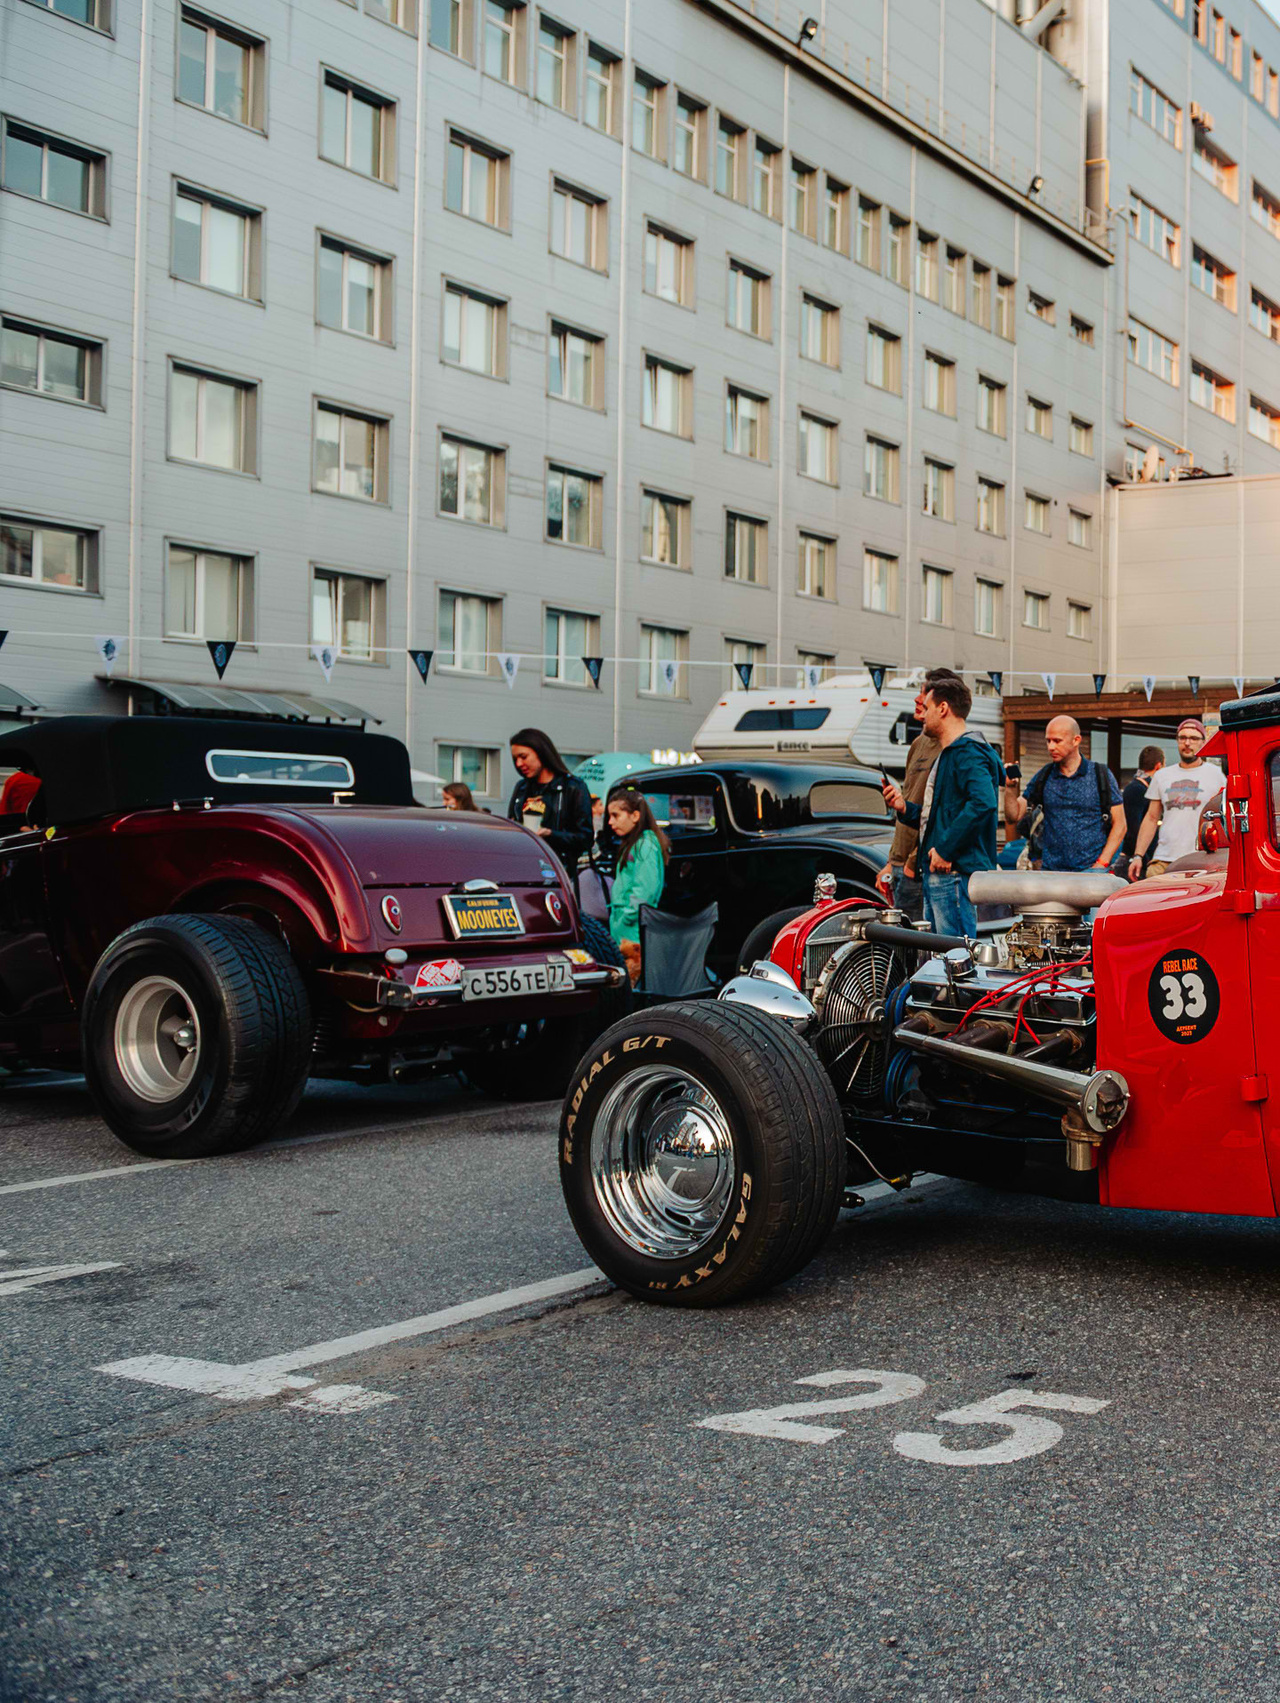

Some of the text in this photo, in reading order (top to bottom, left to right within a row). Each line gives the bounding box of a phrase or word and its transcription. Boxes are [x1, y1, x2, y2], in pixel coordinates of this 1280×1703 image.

[456, 908, 518, 930] MOONEYES
[548, 965, 566, 982] 77
[1162, 958, 1198, 973] REBEL RACE
[1160, 972, 1207, 1020] 33
[563, 1035, 673, 1165] RADIAL G/T
[672, 1172, 752, 1290] GALAXY
[696, 1369, 1112, 1467] 25
